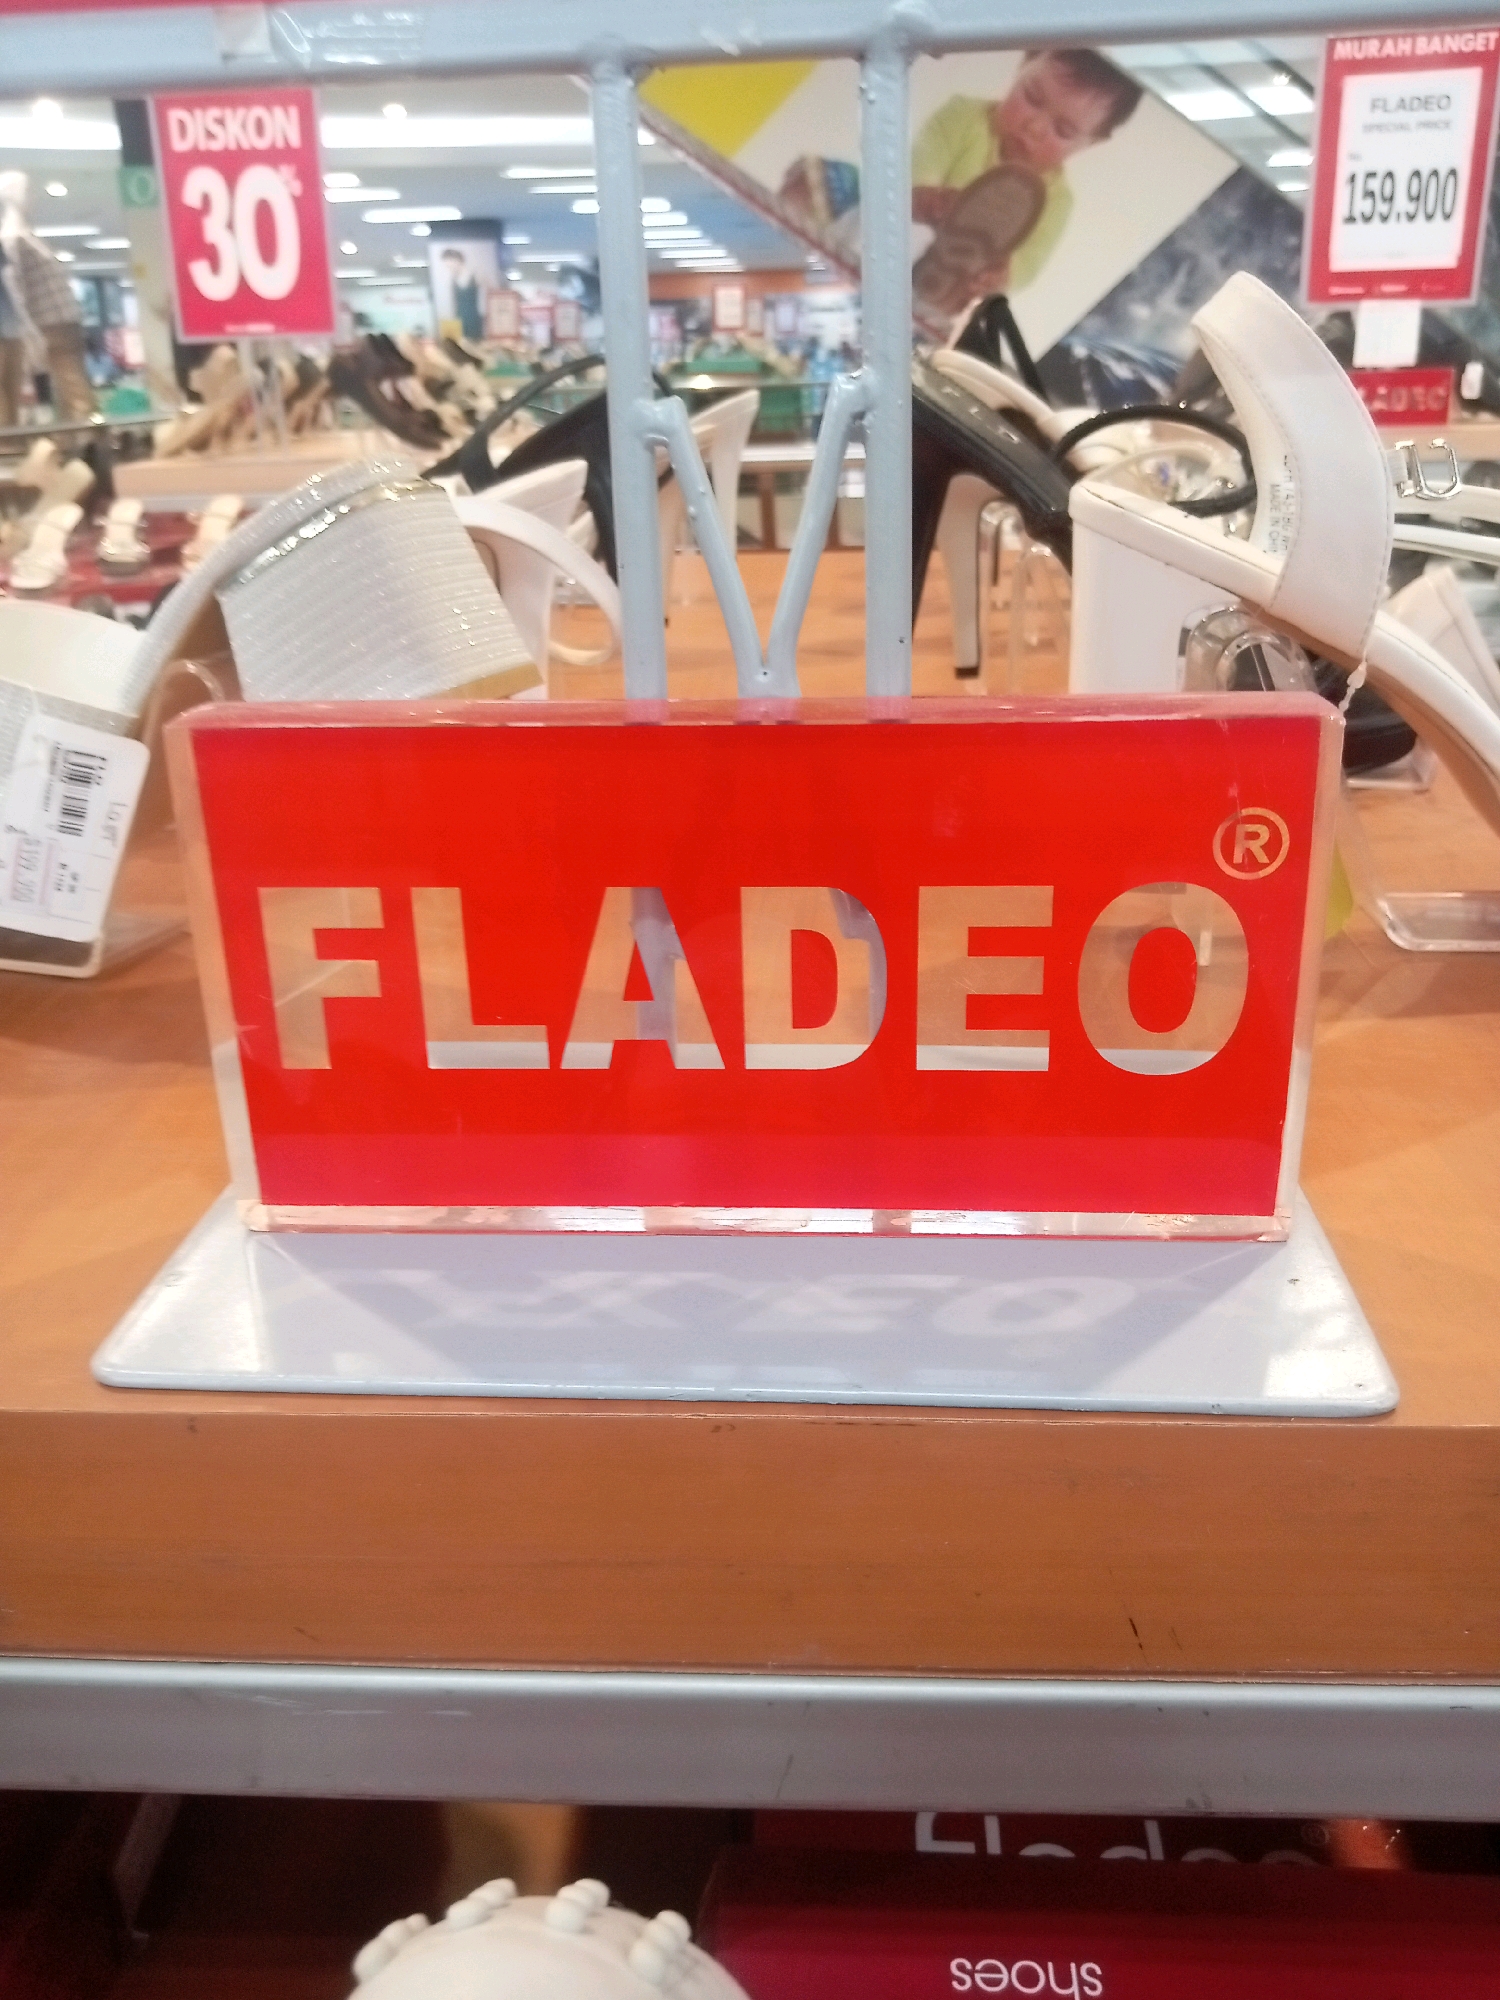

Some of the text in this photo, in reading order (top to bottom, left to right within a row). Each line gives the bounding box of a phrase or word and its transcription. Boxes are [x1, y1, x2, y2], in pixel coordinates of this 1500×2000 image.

[1333, 31, 1499, 61] MURAH BANGET
[1370, 94, 1451, 113] FLADEO
[167, 105, 302, 152] DISKON
[1343, 168, 1458, 225] 159.900
[256, 880, 1250, 1076] FLADEO
[950, 1957, 1103, 2000] shoes
